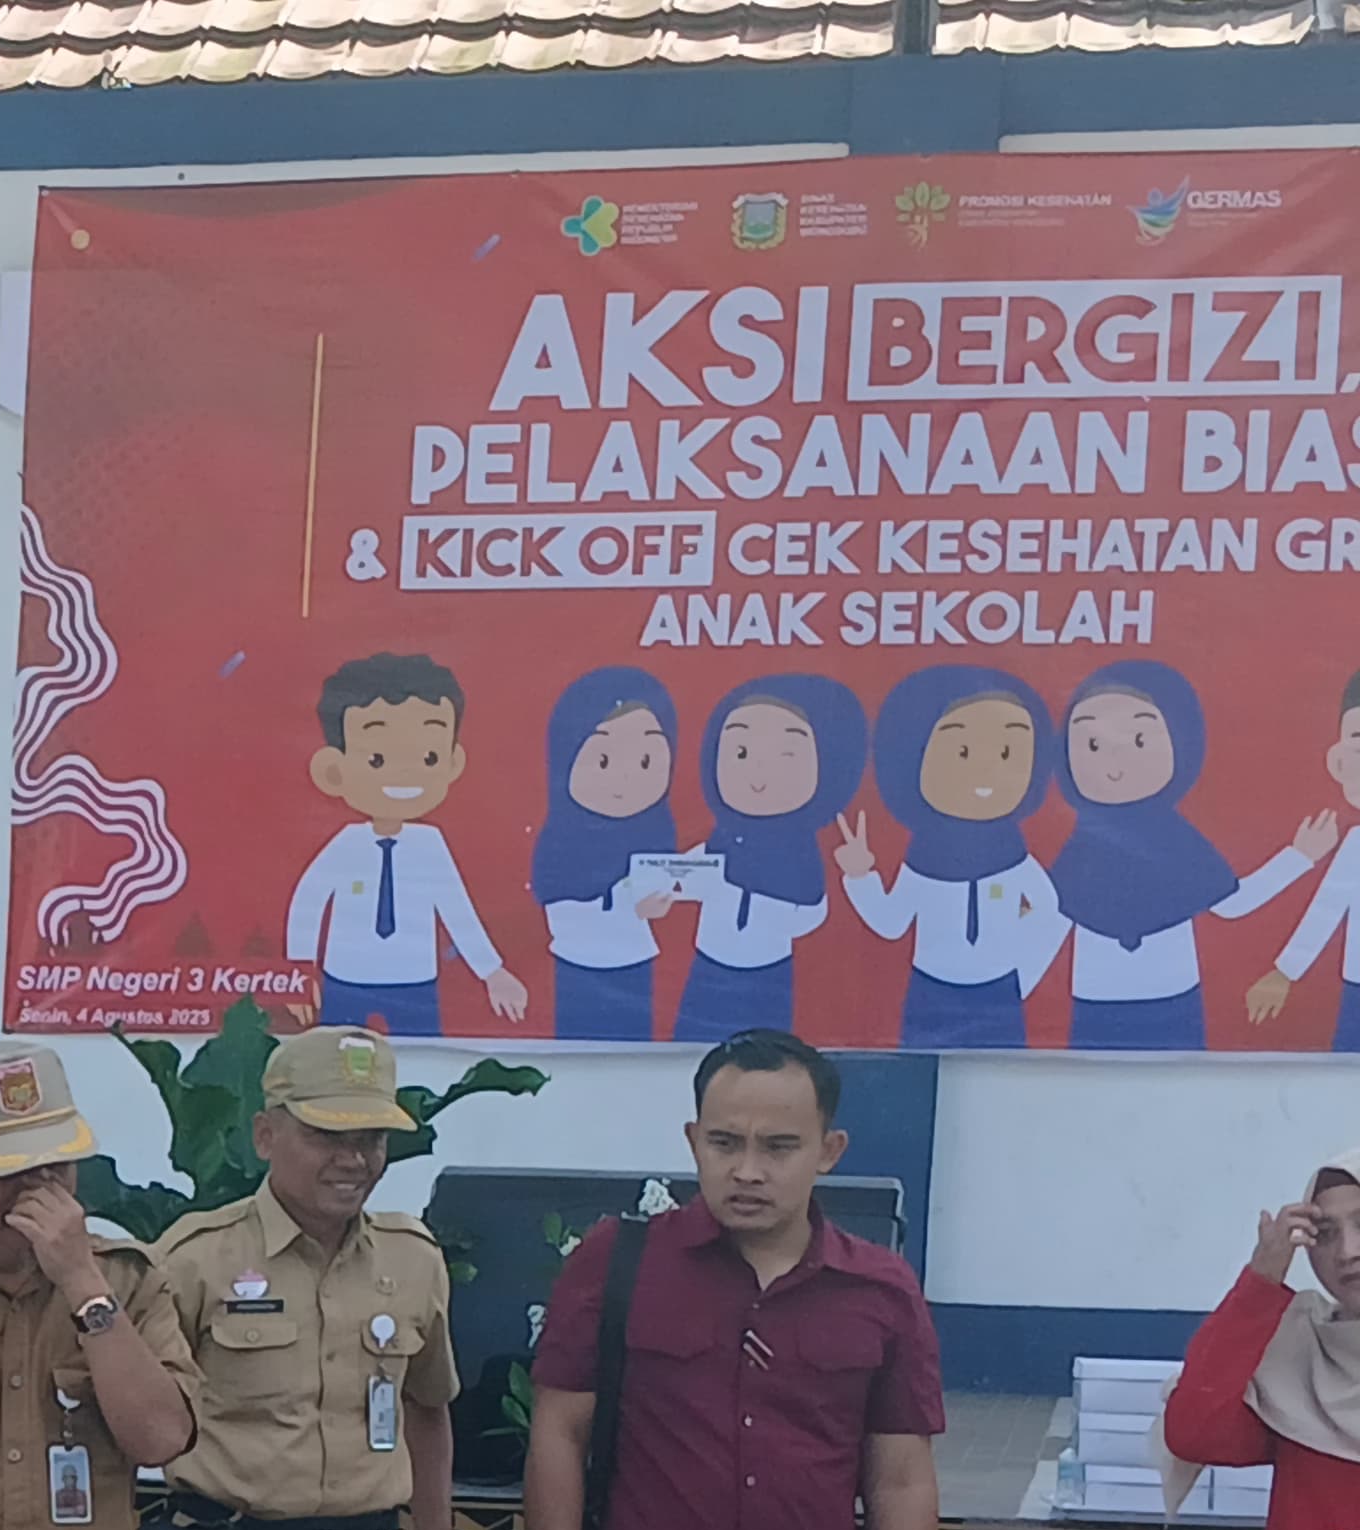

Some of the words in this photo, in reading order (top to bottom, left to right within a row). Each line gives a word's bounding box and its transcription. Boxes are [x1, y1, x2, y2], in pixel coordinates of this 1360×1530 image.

[1186, 189, 1282, 209] GERMAS
[489, 285, 829, 411] AKSI
[410, 409, 1148, 505] PELAKSANAAN
[345, 528, 387, 582] &
[416, 527, 563, 580] KICK
[579, 522, 705, 577] OFF
[728, 520, 863, 576] CEK
[878, 517, 1259, 575] KESEHATAN
[640, 593, 824, 648] ANAK
[840, 590, 1154, 645] SEKOLAH
[16, 966, 81, 993] SMP
[86, 966, 181, 998] Negeri
[187, 968, 204, 993] 3
[212, 968, 307, 994] Kertek
